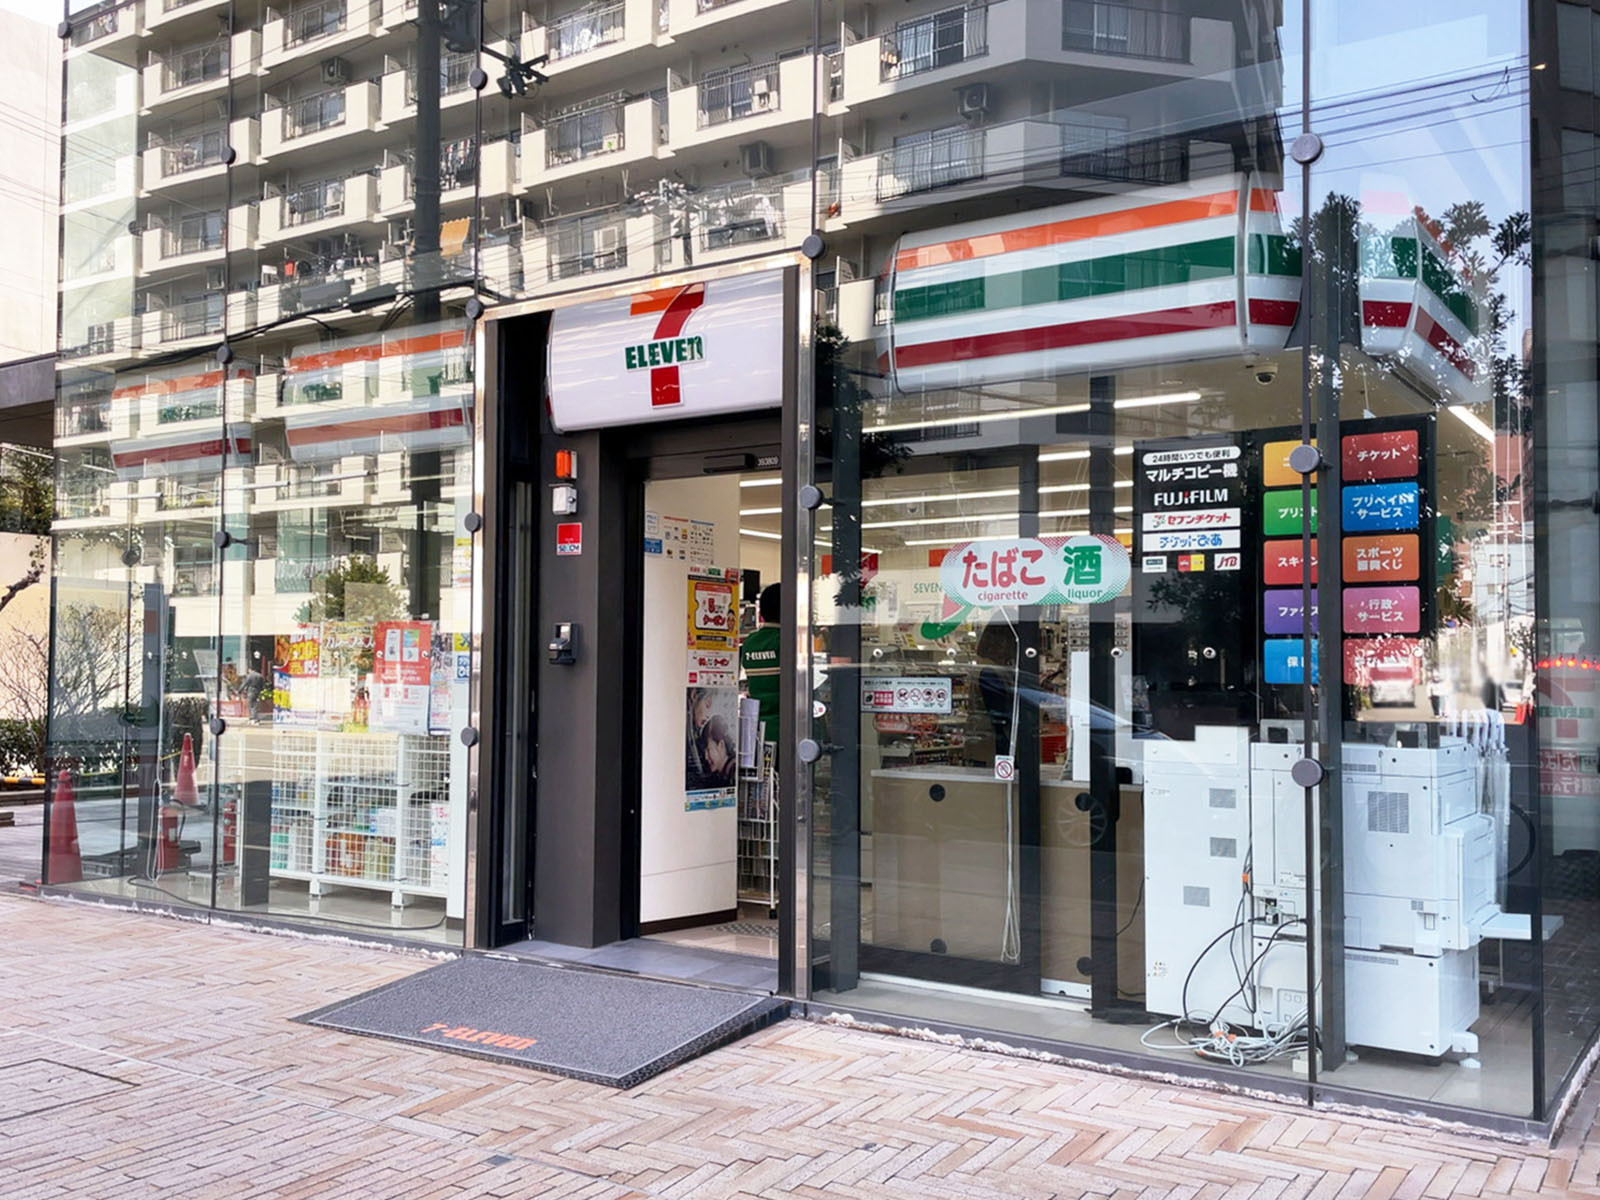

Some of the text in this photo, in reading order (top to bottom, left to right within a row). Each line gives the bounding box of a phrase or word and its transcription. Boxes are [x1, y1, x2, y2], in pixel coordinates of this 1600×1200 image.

[1152, 449, 1231, 463] 24時間いつでも便利
[1357, 448, 1401, 462] チケット
[1145, 463, 1238, 483] マルチコピー機
[1278, 506, 1318, 519] プリト
[1356, 507, 1404, 520] サービス
[1356, 546, 1404, 559] スポーツ
[962, 545, 1103, 588] たばこ 酒
[1217, 556, 1238, 569] JTB
[1278, 555, 1318, 568] スキン
[978, 587, 1103, 602] cigarette liquor
[1357, 611, 1404, 623] サービス
